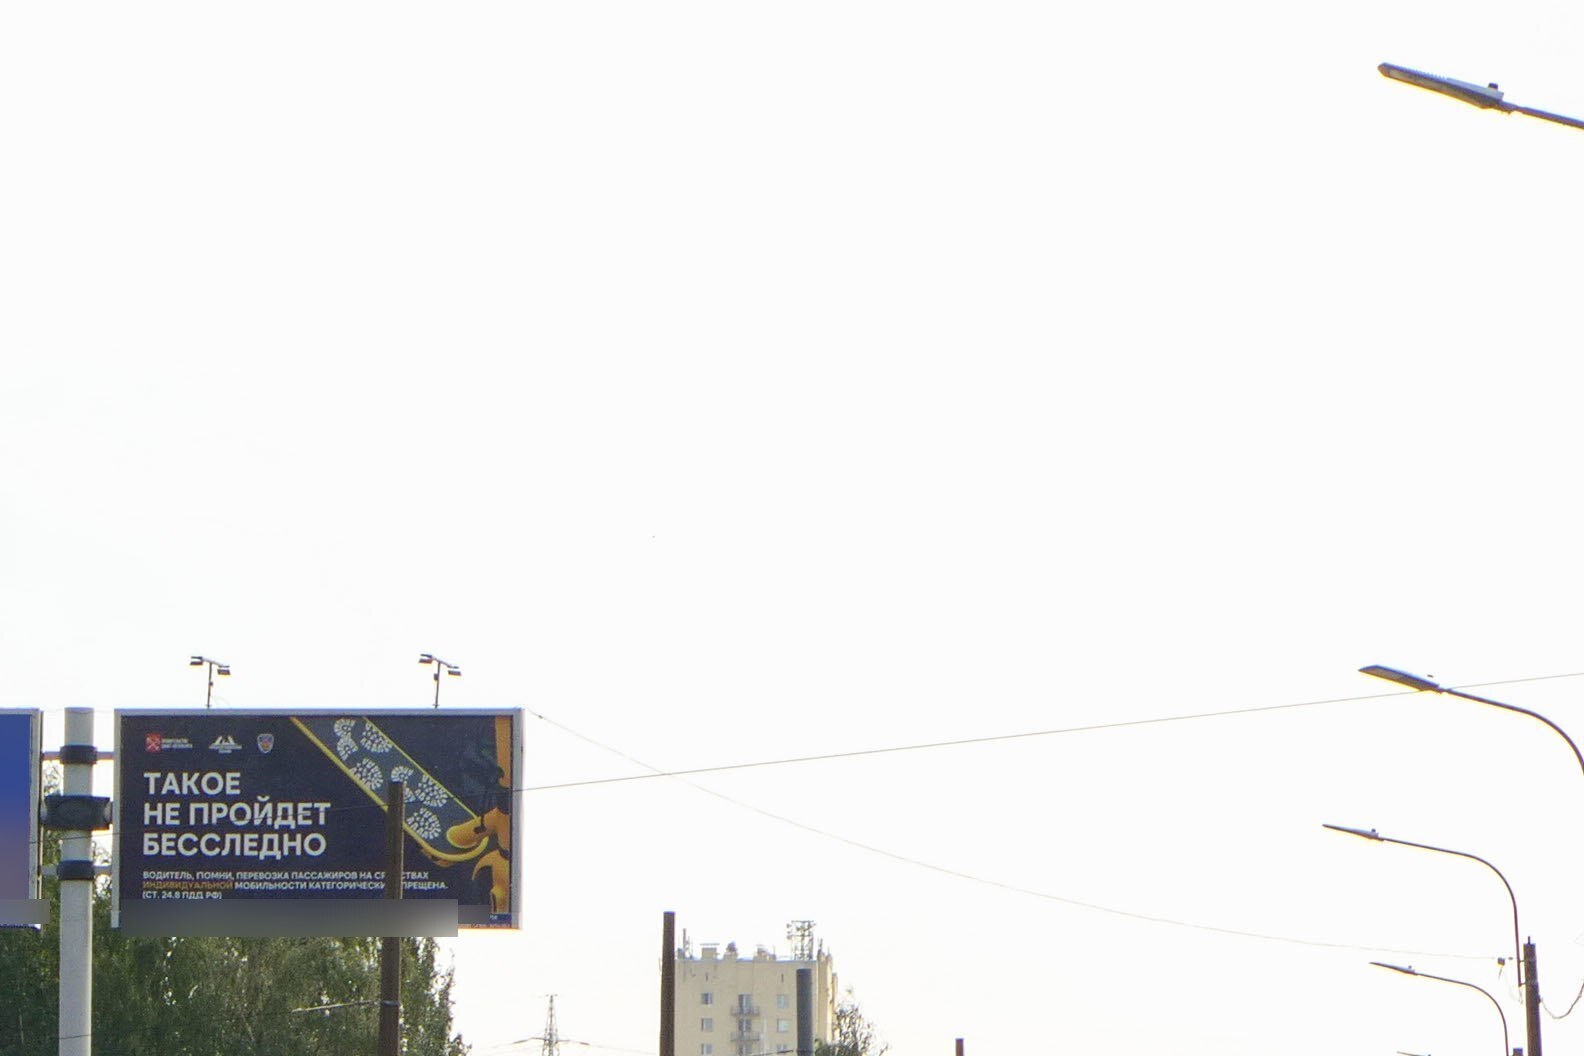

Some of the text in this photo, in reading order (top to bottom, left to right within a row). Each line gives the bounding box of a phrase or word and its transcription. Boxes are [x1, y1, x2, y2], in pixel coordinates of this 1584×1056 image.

[143, 772, 241, 795] ТАКОЕ
[144, 796, 331, 829] НЕ ПРОЙДЕТ
[143, 833, 327, 860] БЕССЛЕДНО
[142, 871, 194, 880] ВОДИТЕЛЬ,
[196, 871, 234, 880] ПОМНИ,
[236, 871, 290, 880] ПЕРЕВОЗКА
[291, 871, 358, 880] ПАССАЖИРОВ
[359, 871, 373, 880] НА
[142, 880, 233, 890] ИНДИВИДУАЛЬНОЙ
[234, 881, 306, 890] МОБИЛЬНОСТИ
[182, 891, 204, 899] ПДД
[206, 891, 223, 899] РФ)
